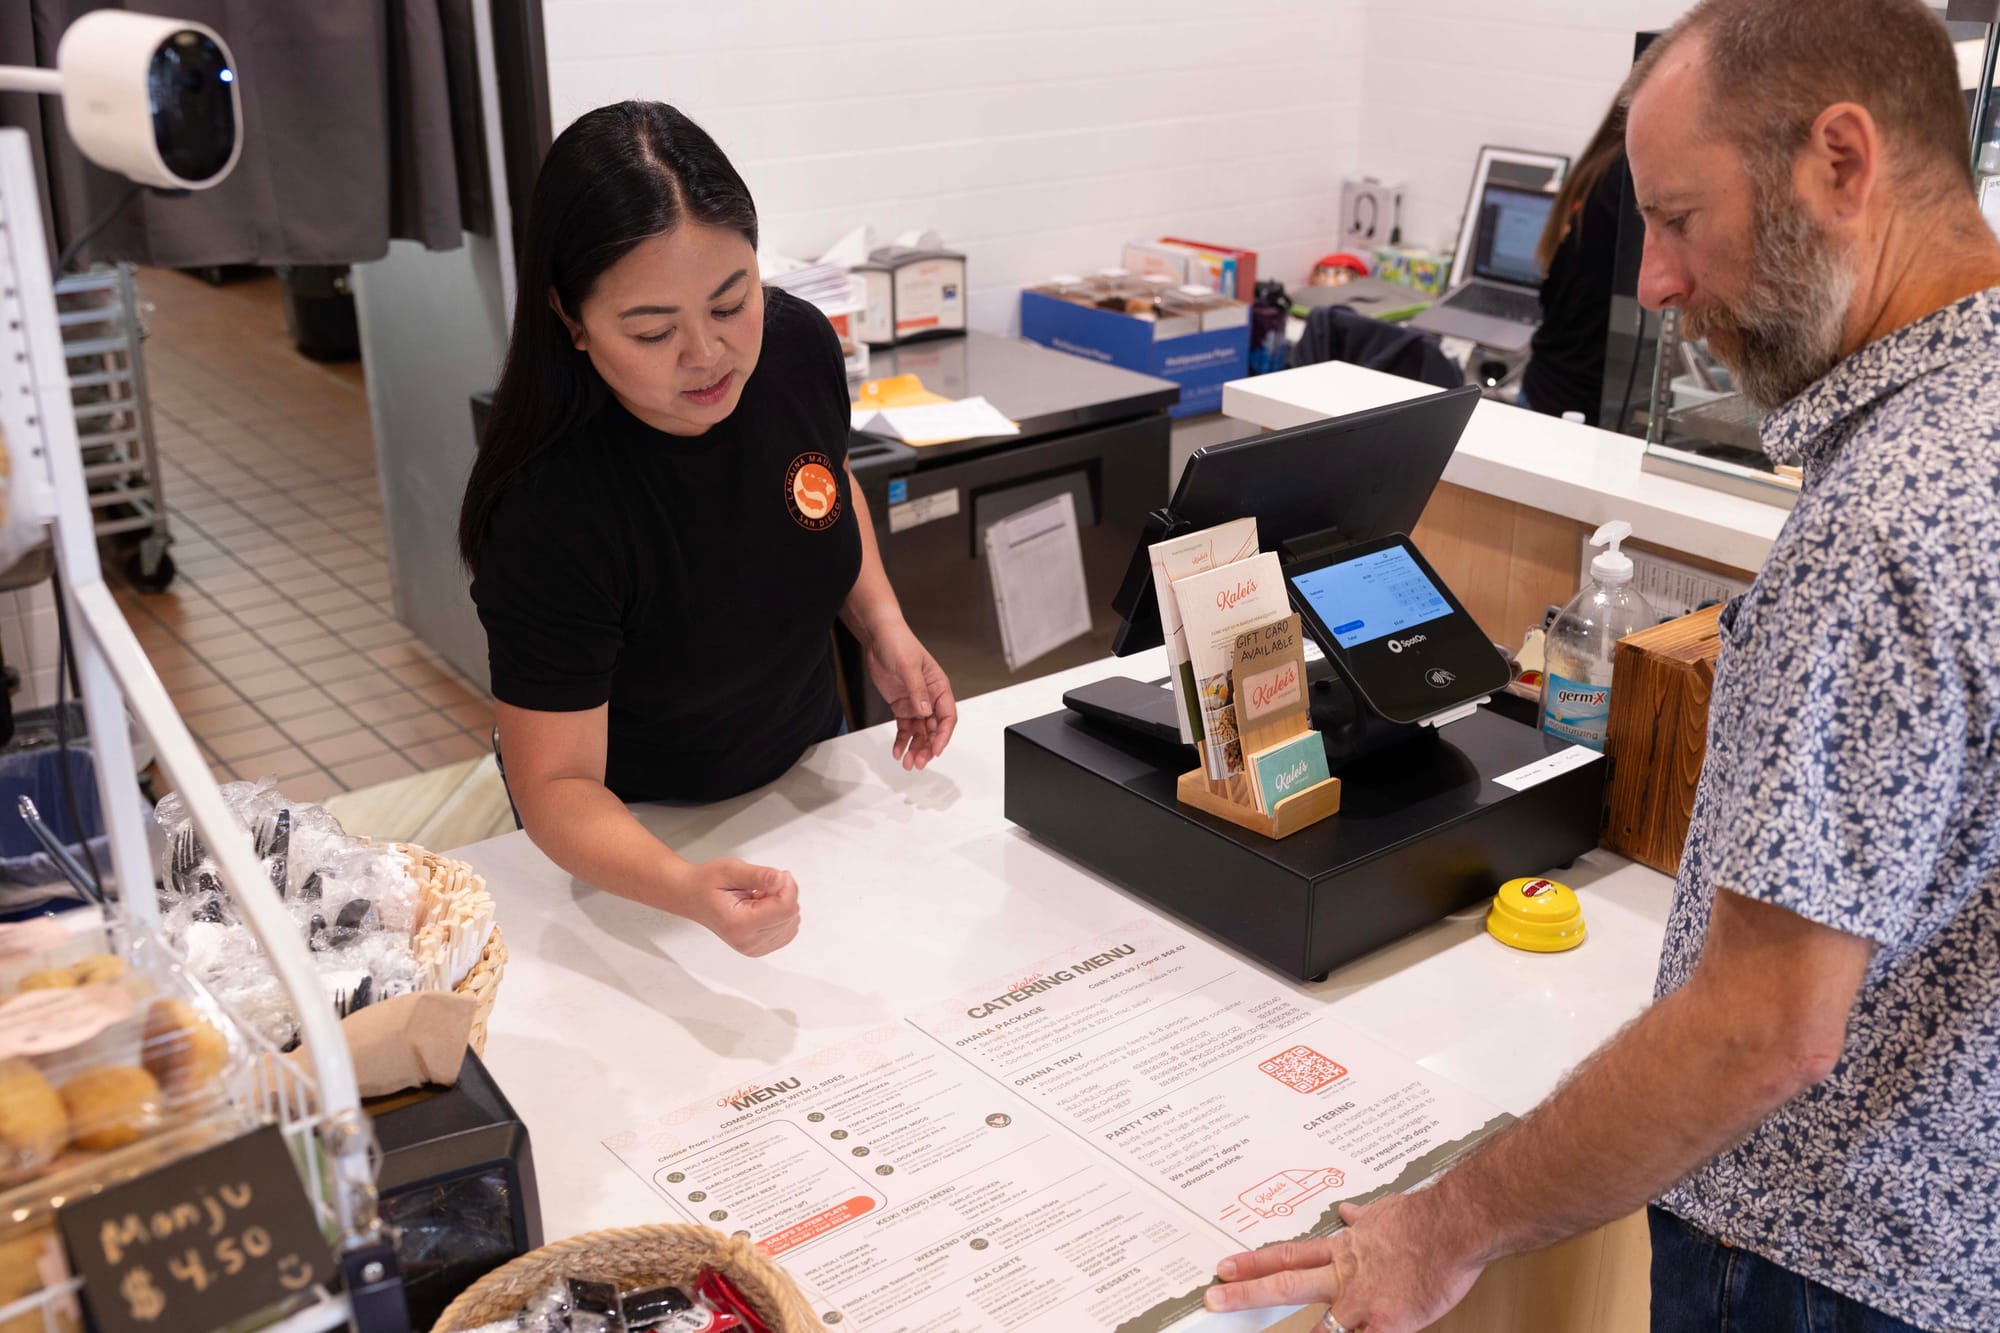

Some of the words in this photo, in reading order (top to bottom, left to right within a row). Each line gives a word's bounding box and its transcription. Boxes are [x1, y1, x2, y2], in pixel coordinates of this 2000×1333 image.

[787, 458, 806, 501] LAHAINA
[808, 455, 832, 469] MAUI
[798, 514, 816, 528] SAN
[819, 502, 841, 528] DIEGO
[1216, 578, 1258, 612] Kalei's
[1236, 631, 1260, 649] GIFT
[1264, 620, 1289, 640] CARD
[1240, 634, 1294, 663] AVAILABLE
[1400, 634, 1427, 648] SpotOn
[1252, 667, 1297, 710] Kalei's
[1547, 719, 1599, 740] moisturizing
[1274, 758, 1309, 792] Kalei's
[968, 971, 1075, 1018] CATERING
[1072, 944, 1135, 974] MENU
[1009, 973, 1050, 993] Kalei's
[956, 1029, 995, 1047] OHANA
[995, 1007, 1045, 1029] PACKAGE
[1015, 1067, 1055, 1086] OHANA
[1053, 1052, 1083, 1067] TRAY
[718, 1086, 767, 1107] Kalei's
[720, 1113, 753, 1129] COMBO
[755, 1099, 787, 1114] COMES
[787, 1088, 811, 1100] WITH
[819, 1075, 845, 1087] SIDES
[731, 1077, 800, 1111] MENU
[1106, 1119, 1142, 1140] PARTY
[1143, 1104, 1172, 1121] TRAY
[1142, 1136, 1162, 1147] have
[1168, 1122, 1190, 1134] huge
[1190, 1104, 1226, 1123] selection
[1304, 1102, 1355, 1130] CATERING
[684, 1162, 701, 1172] HULI
[701, 1155, 719, 1164] HULI
[719, 1142, 750, 1156] CHICKEN
[1361, 1156, 1376, 1165] We
[1376, 1141, 1402, 1158] require
[1401, 1134, 1414, 1142] 30
[1413, 1125, 1431, 1136] days
[1373, 1153, 1405, 1172] advance
[1405, 1139, 1431, 1154] notice.
[705, 1177, 731, 1190] GARLIC
[732, 1164, 763, 1179] CHICKEN
[1169, 1173, 1185, 1182] We
[1185, 1158, 1214, 1174] require
[1213, 1152, 1223, 1160] 7
[1221, 1143, 1241, 1155] days
[1181, 1169, 1215, 1189] advance
[1216, 1156, 1242, 1171] notice.
[876, 1213, 900, 1226] KEIKI
[901, 1199, 929, 1214] (KIDS)
[929, 1186, 956, 1200] MENU
[1255, 1183, 1288, 1204] Kalei's
[915, 1239, 959, 1262] WEEKEND
[960, 1218, 1002, 1240] SPECIALS
[973, 1272, 992, 1283] ALA
[992, 1256, 1021, 1273] CARTE
[1096, 1268, 1141, 1294] DESSERTS
